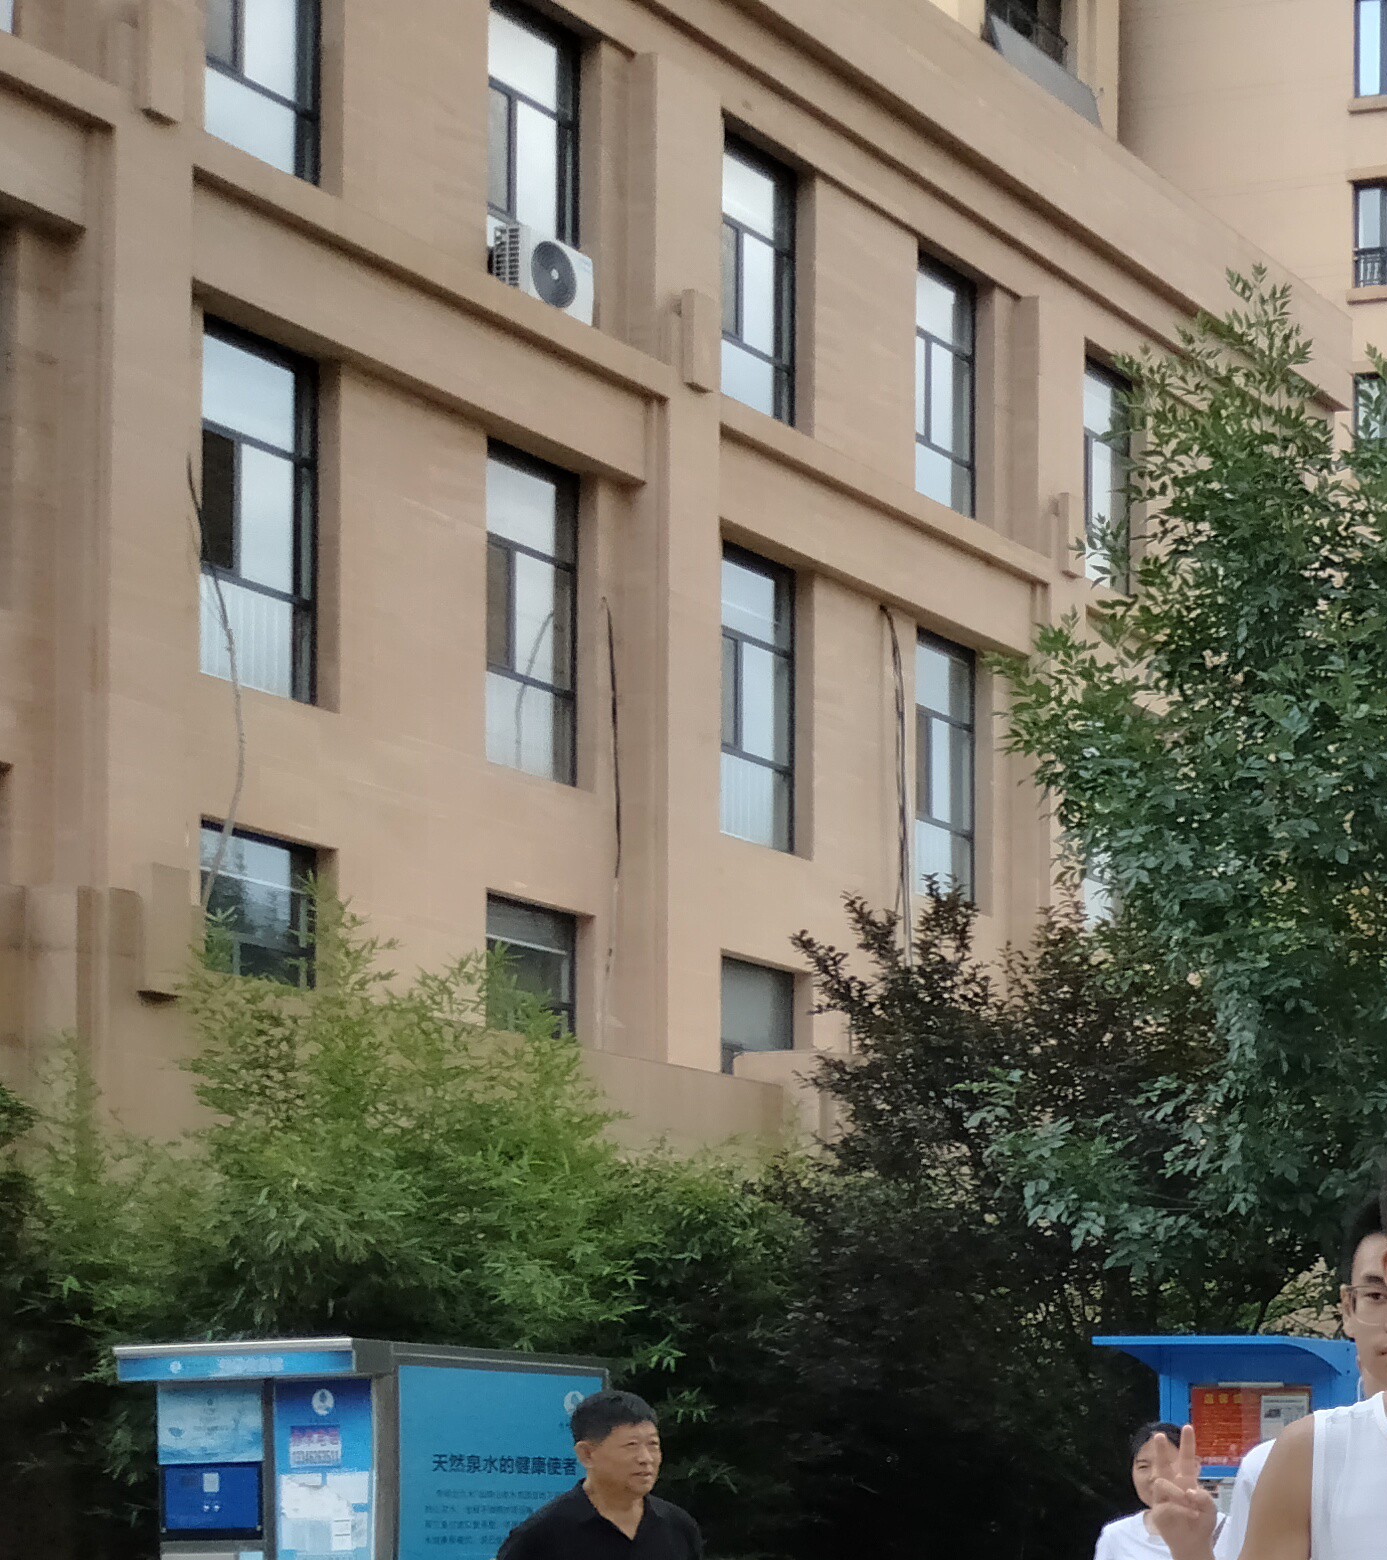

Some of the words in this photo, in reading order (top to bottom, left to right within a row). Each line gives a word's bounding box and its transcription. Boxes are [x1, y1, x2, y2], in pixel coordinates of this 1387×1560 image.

[431, 1453, 578, 1477] 天然泉水的健康使者
